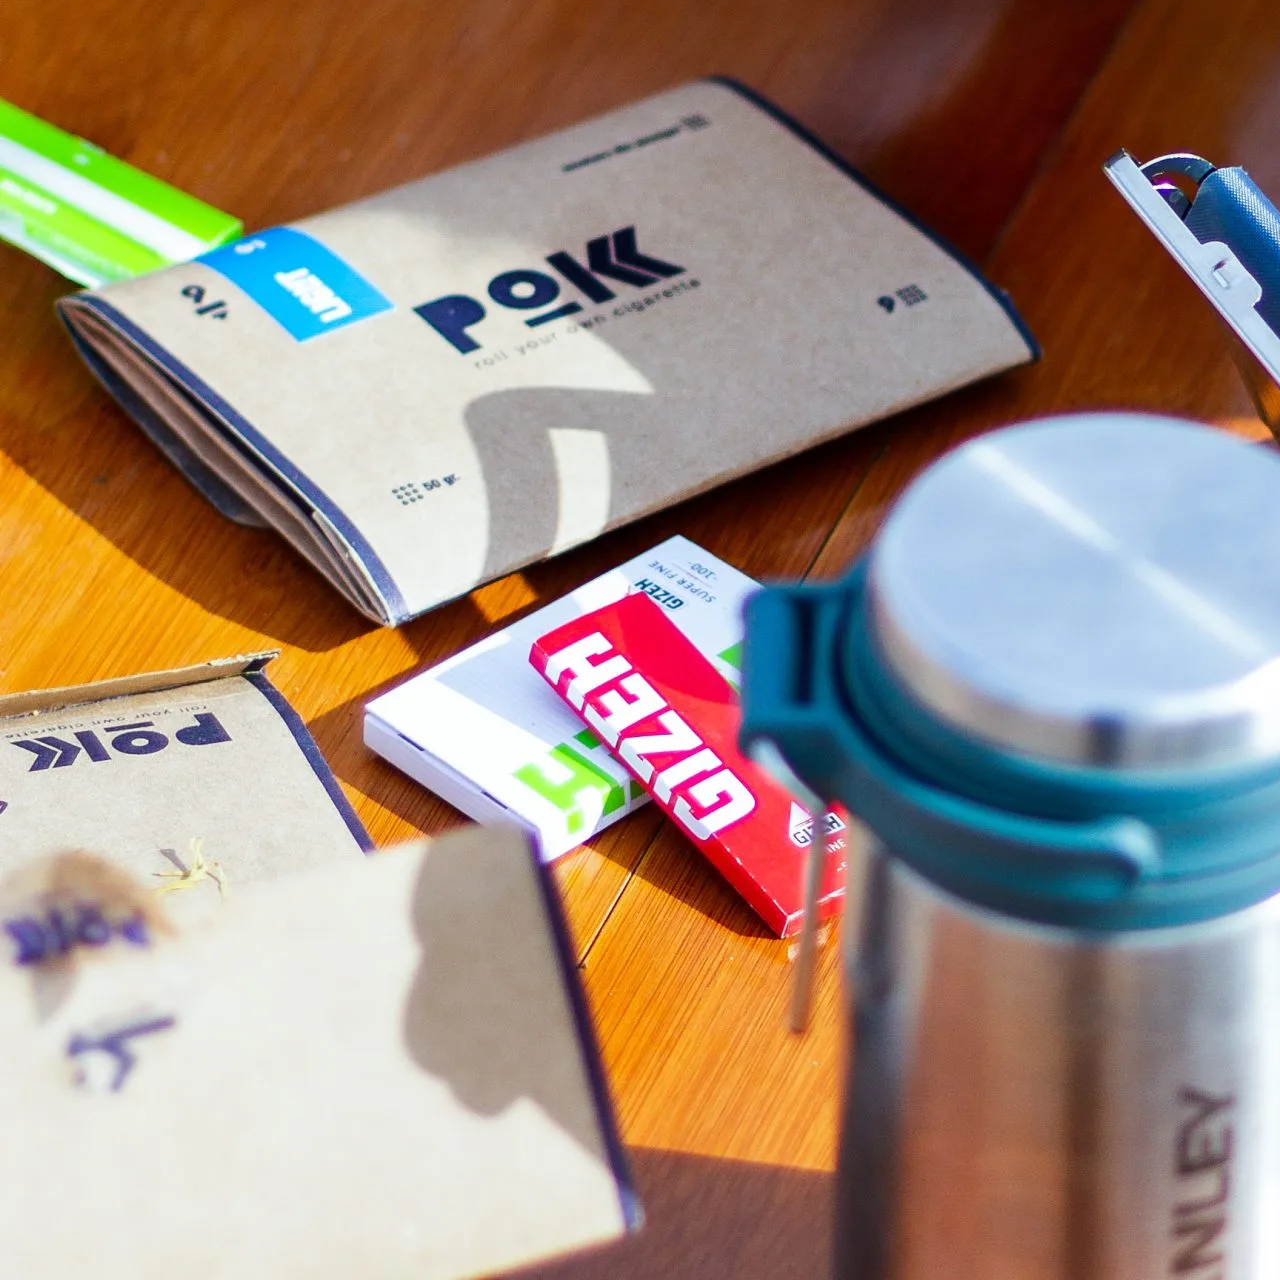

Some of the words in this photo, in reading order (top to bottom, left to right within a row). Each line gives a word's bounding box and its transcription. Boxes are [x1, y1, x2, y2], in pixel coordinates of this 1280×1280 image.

[474, 347, 508, 370] roll
[513, 331, 558, 356] your
[566, 314, 607, 335] own
[612, 277, 701, 318] cigarette
[421, 478, 441, 492] 50
[648, 559, 678, 580] FINE
[634, 578, 685, 610] GIZEH
[677, 578, 716, 603] SUPER
[91, 716, 126, 726] own
[134, 708, 174, 720] your
[4, 724, 84, 739] cigarette
[544, 631, 757, 841] GIZEH
[1170, 1085, 1237, 1280] NLEY
